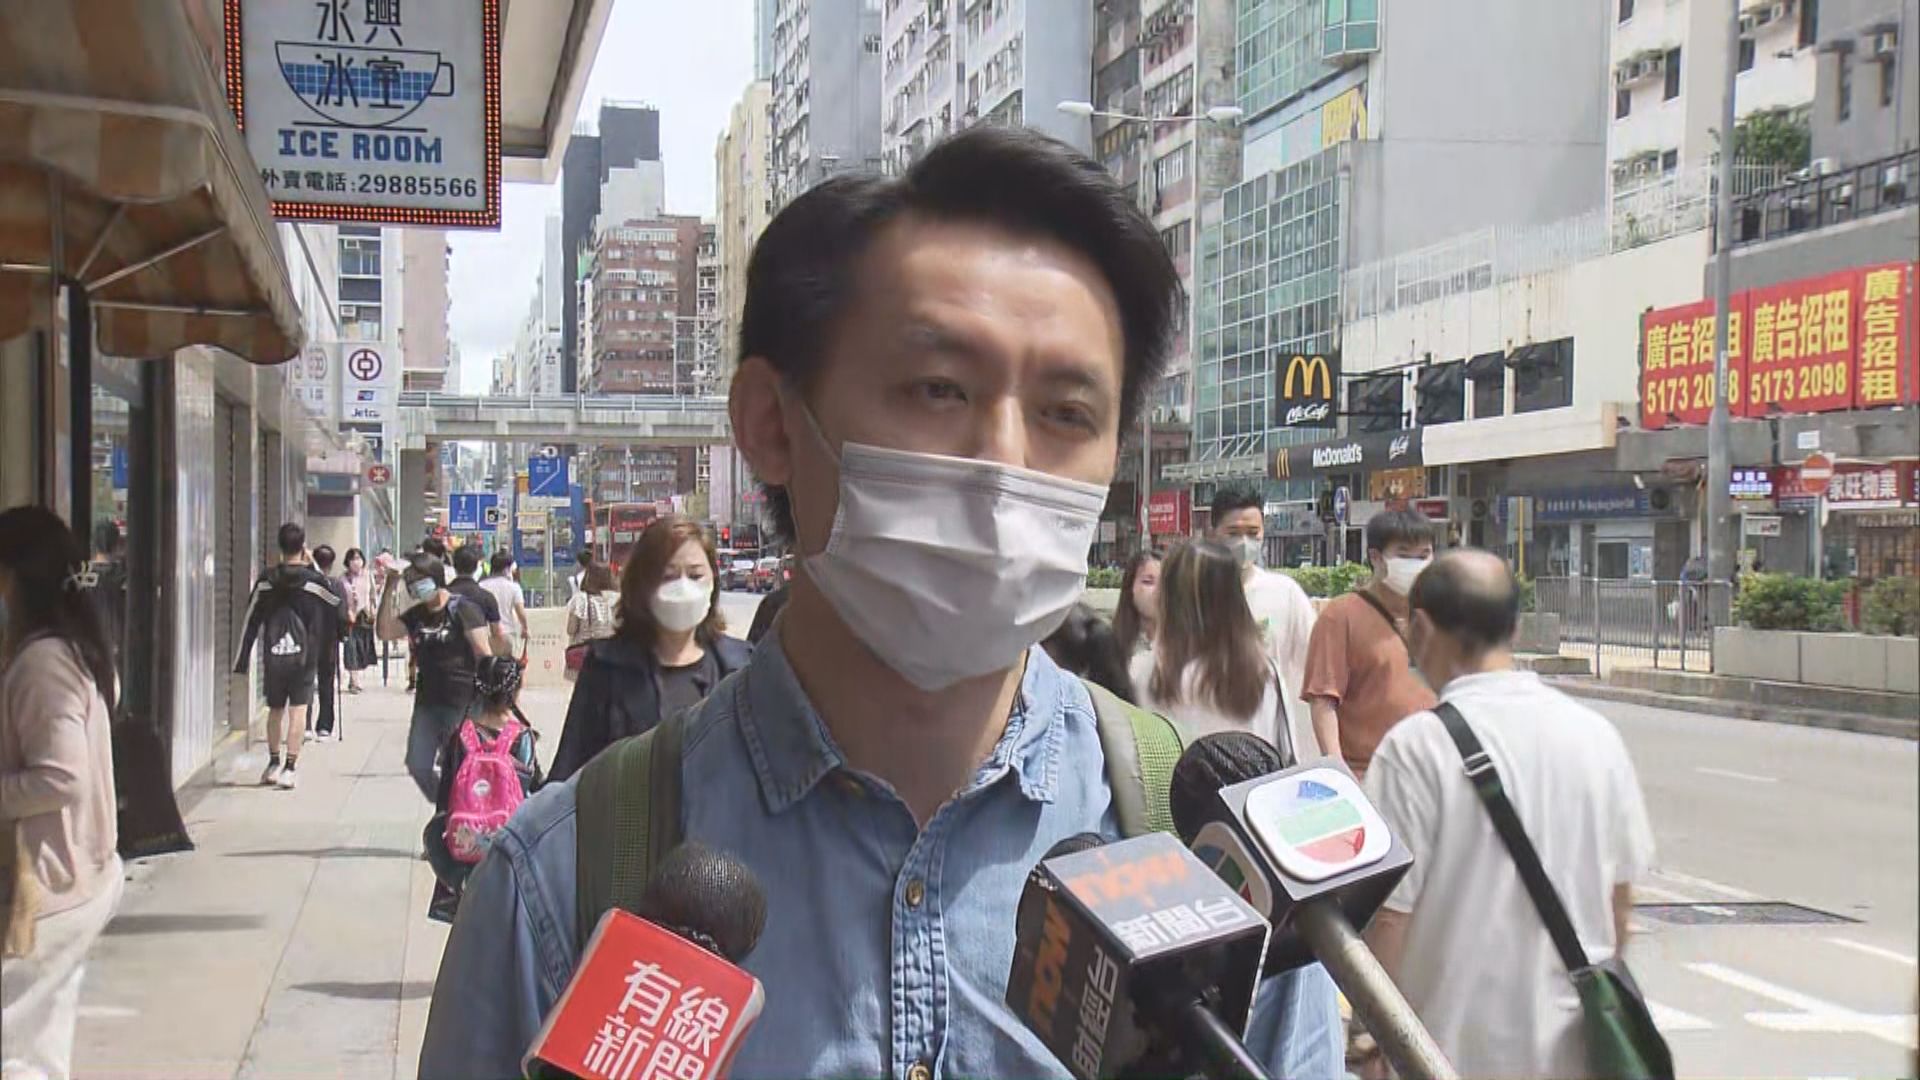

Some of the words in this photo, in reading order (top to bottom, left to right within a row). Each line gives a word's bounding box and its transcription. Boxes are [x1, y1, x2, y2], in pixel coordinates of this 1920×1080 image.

[315, 53, 404, 109] 冰室
[278, 129, 338, 158] ICE
[353, 133, 442, 163] ROOM
[1752, 290, 1849, 363] 廣告招租
[1861, 269, 1901, 403] 廣告招租
[1647, 377, 1689, 414] 5173
[1693, 369, 1740, 409] 208
[1751, 369, 1795, 405] 5173
[1800, 361, 1847, 399] 2098
[1312, 443, 1363, 468] McDonald's
[1112, 896, 1248, 948] 新聞台
[618, 959, 729, 1057] 有線
